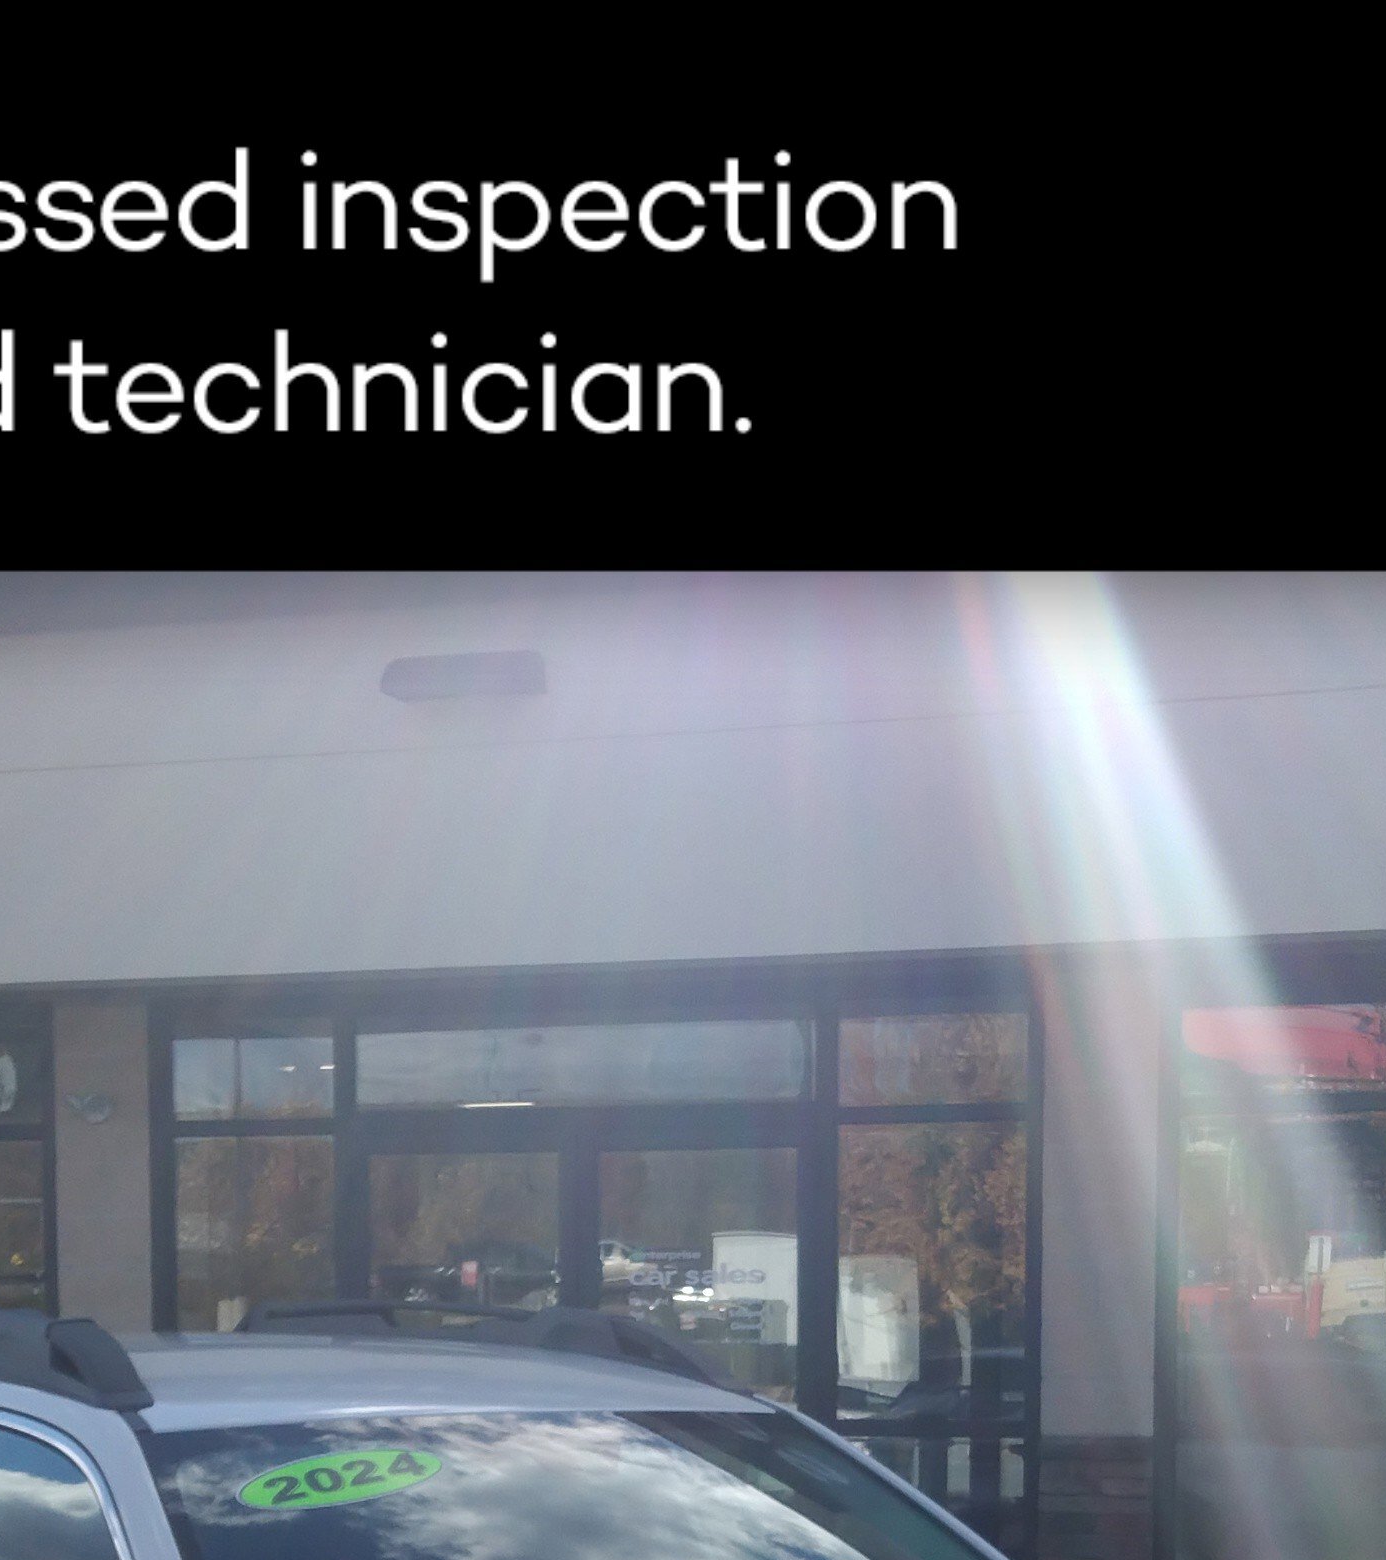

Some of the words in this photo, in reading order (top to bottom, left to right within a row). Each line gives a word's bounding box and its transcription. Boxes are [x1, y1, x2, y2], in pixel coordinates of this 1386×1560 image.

[629, 1269, 677, 1287] car
[684, 1262, 766, 1285] sales
[263, 1451, 427, 1506] 2024
